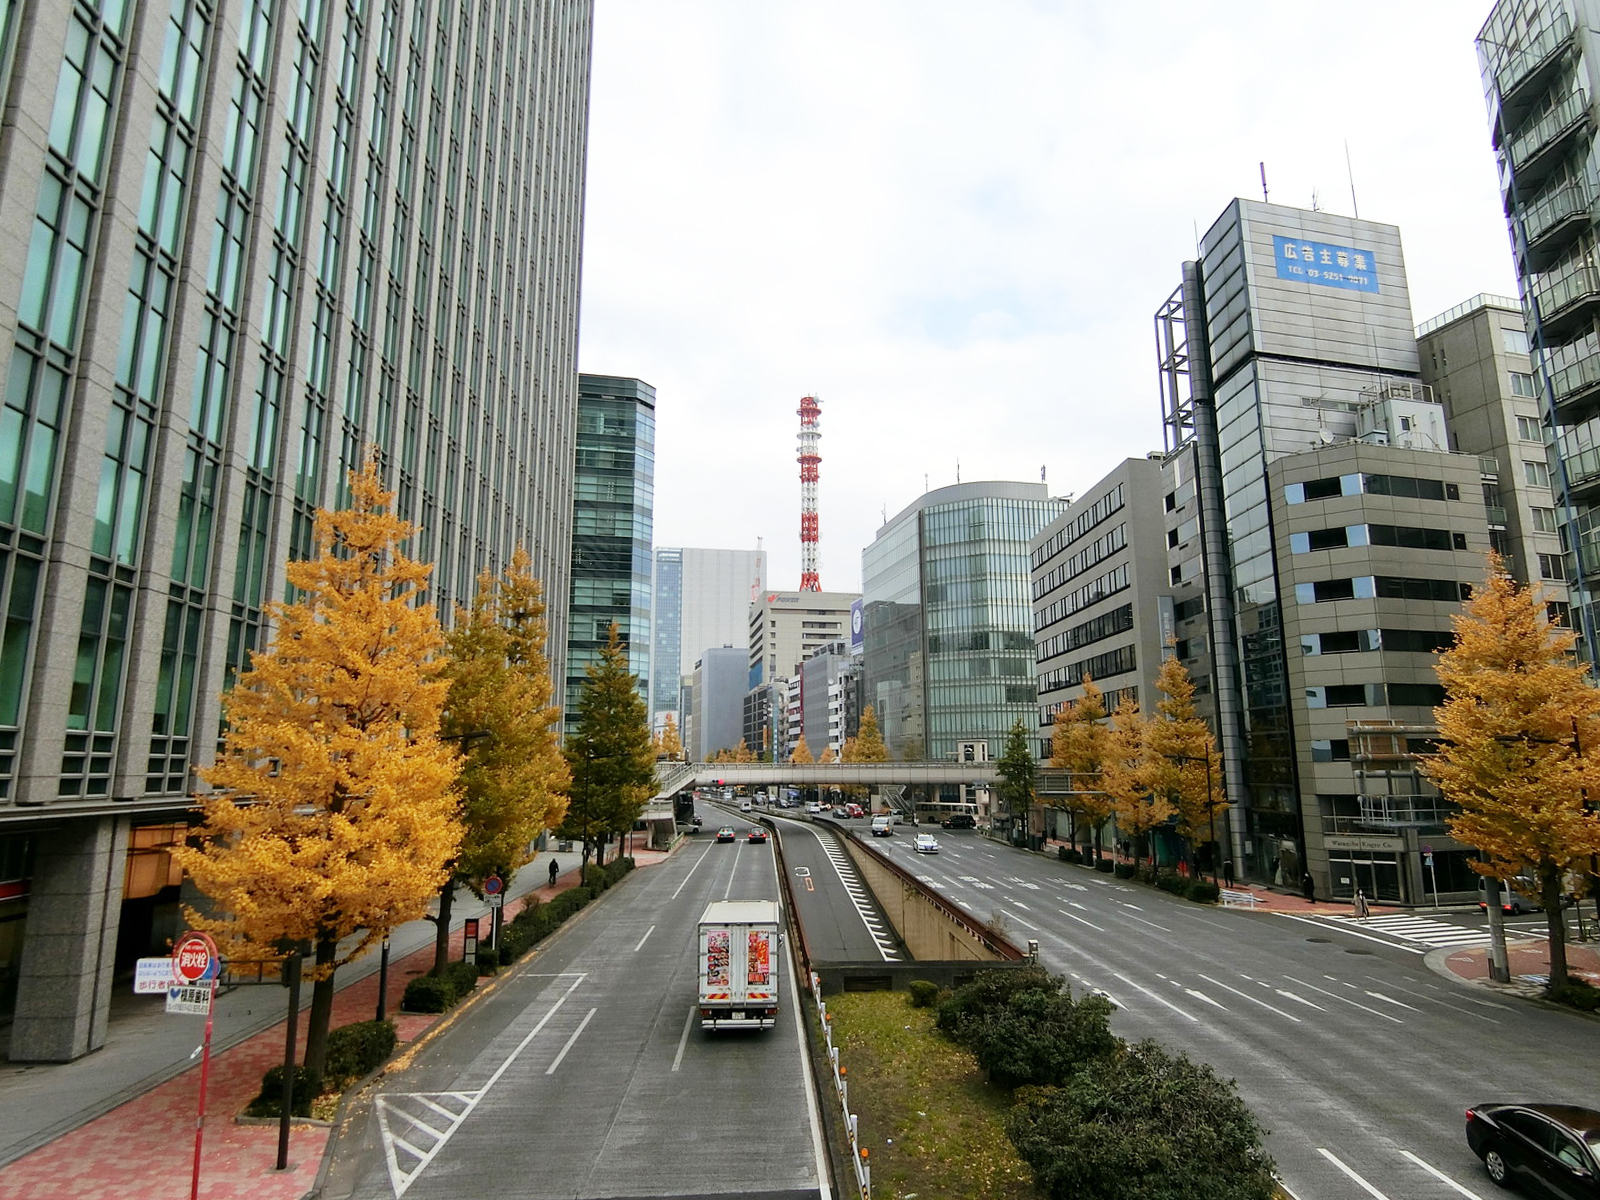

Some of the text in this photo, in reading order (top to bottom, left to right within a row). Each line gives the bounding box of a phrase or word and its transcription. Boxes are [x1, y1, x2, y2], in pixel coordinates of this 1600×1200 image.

[1284, 243, 1367, 270] 広告主募集
[1288, 265, 1303, 274] TEL
[181, 952, 207, 967] 消火栓
